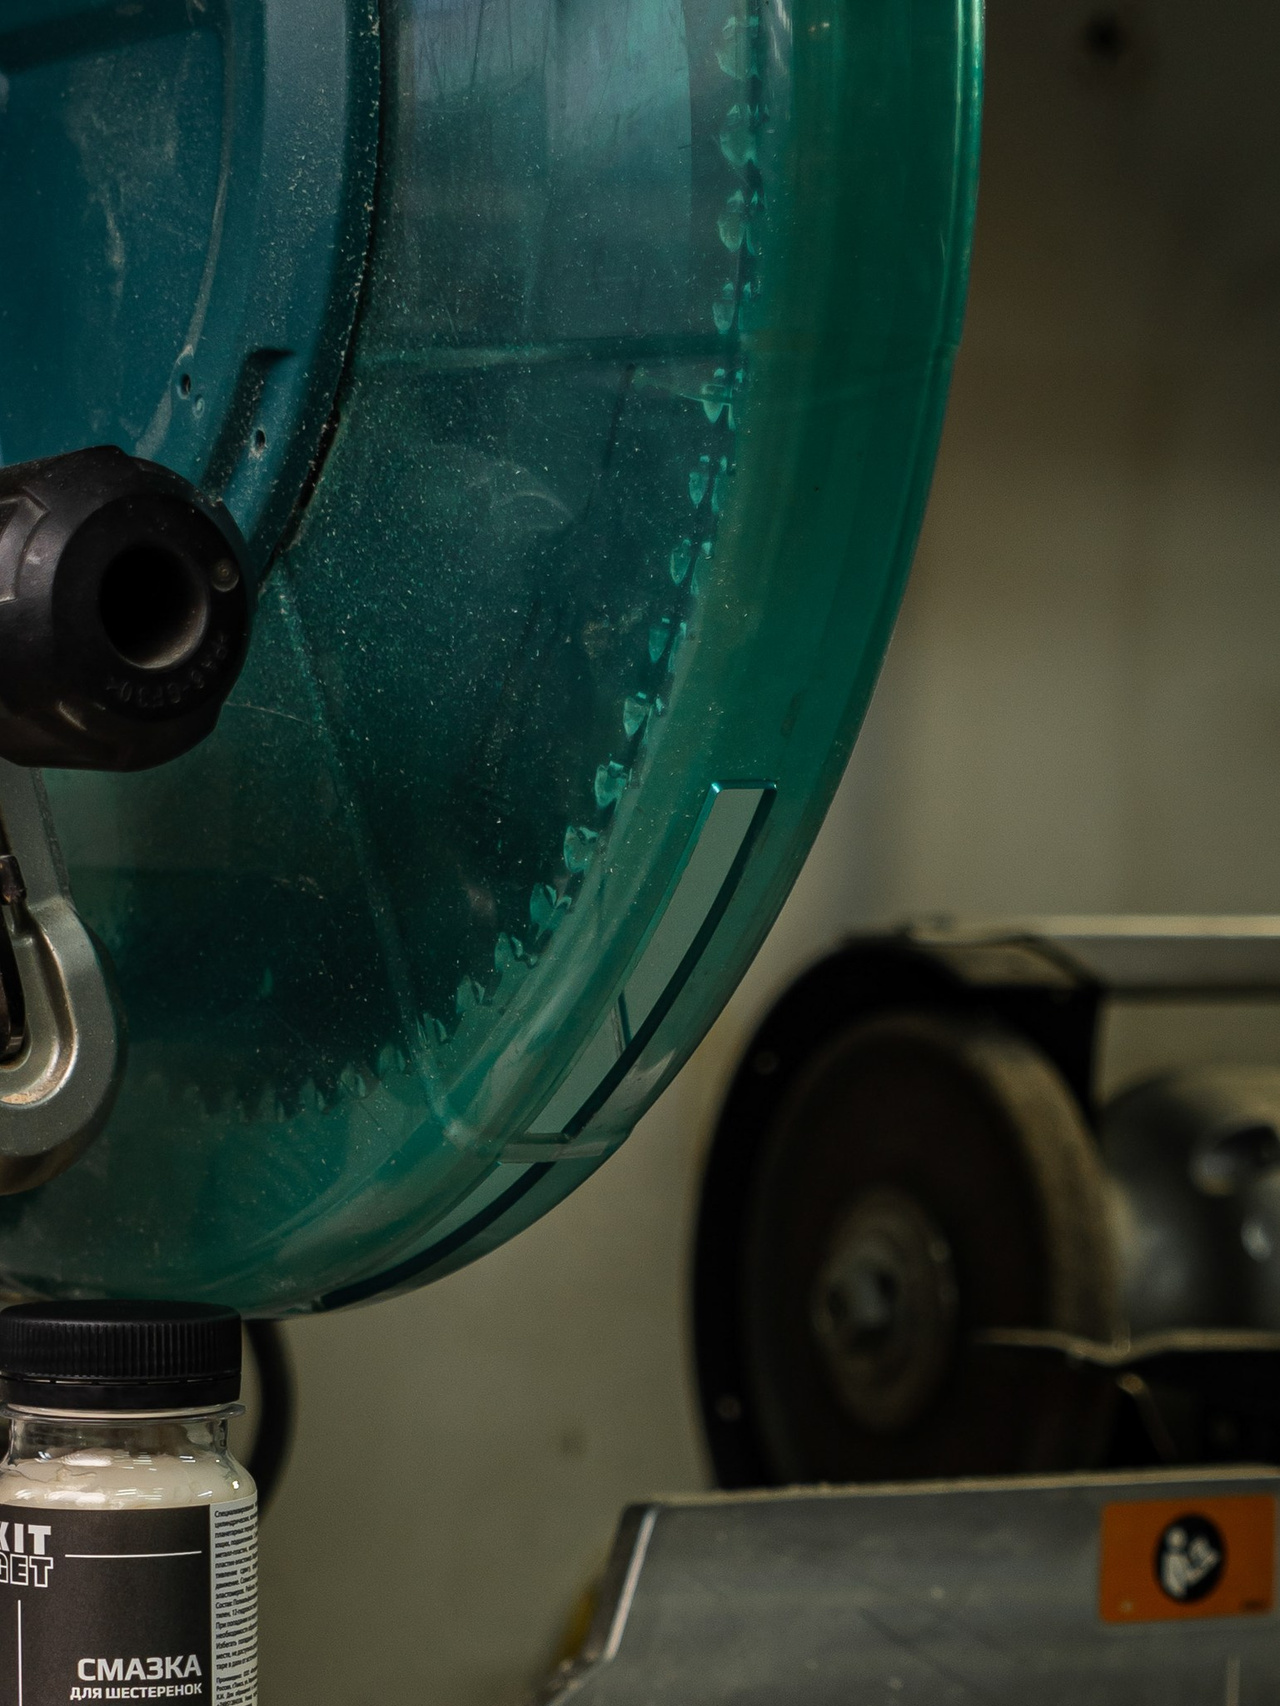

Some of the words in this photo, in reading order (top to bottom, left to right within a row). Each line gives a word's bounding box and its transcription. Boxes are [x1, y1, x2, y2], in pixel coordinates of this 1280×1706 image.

[77, 1654, 202, 1681] СМАЗКА
[70, 1686, 102, 1700] ДЛЯ
[105, 1682, 203, 1699] ШЕСТЕРЕНОК
